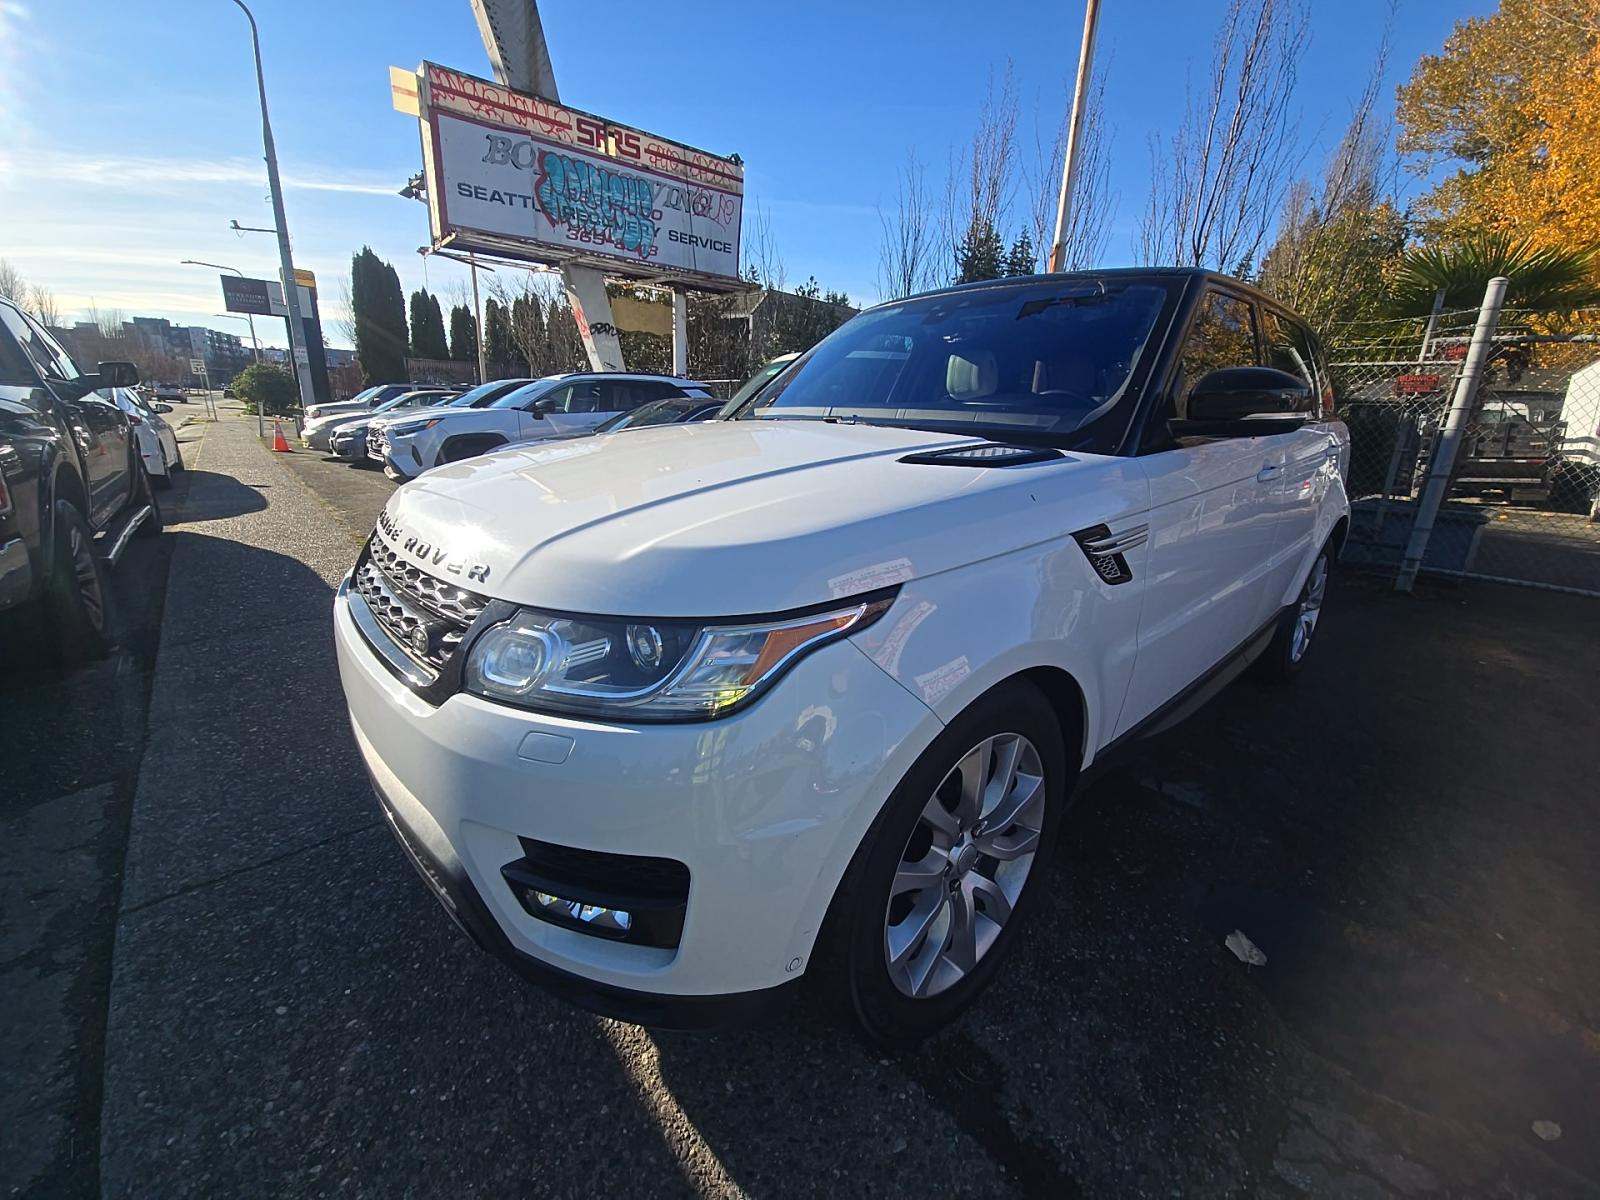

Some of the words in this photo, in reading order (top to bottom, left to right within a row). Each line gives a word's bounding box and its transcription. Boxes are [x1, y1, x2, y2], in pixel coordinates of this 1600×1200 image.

[457, 183, 541, 213] SEATTL
[669, 229, 732, 254] SERVICE
[404, 538, 489, 584] ROVER
